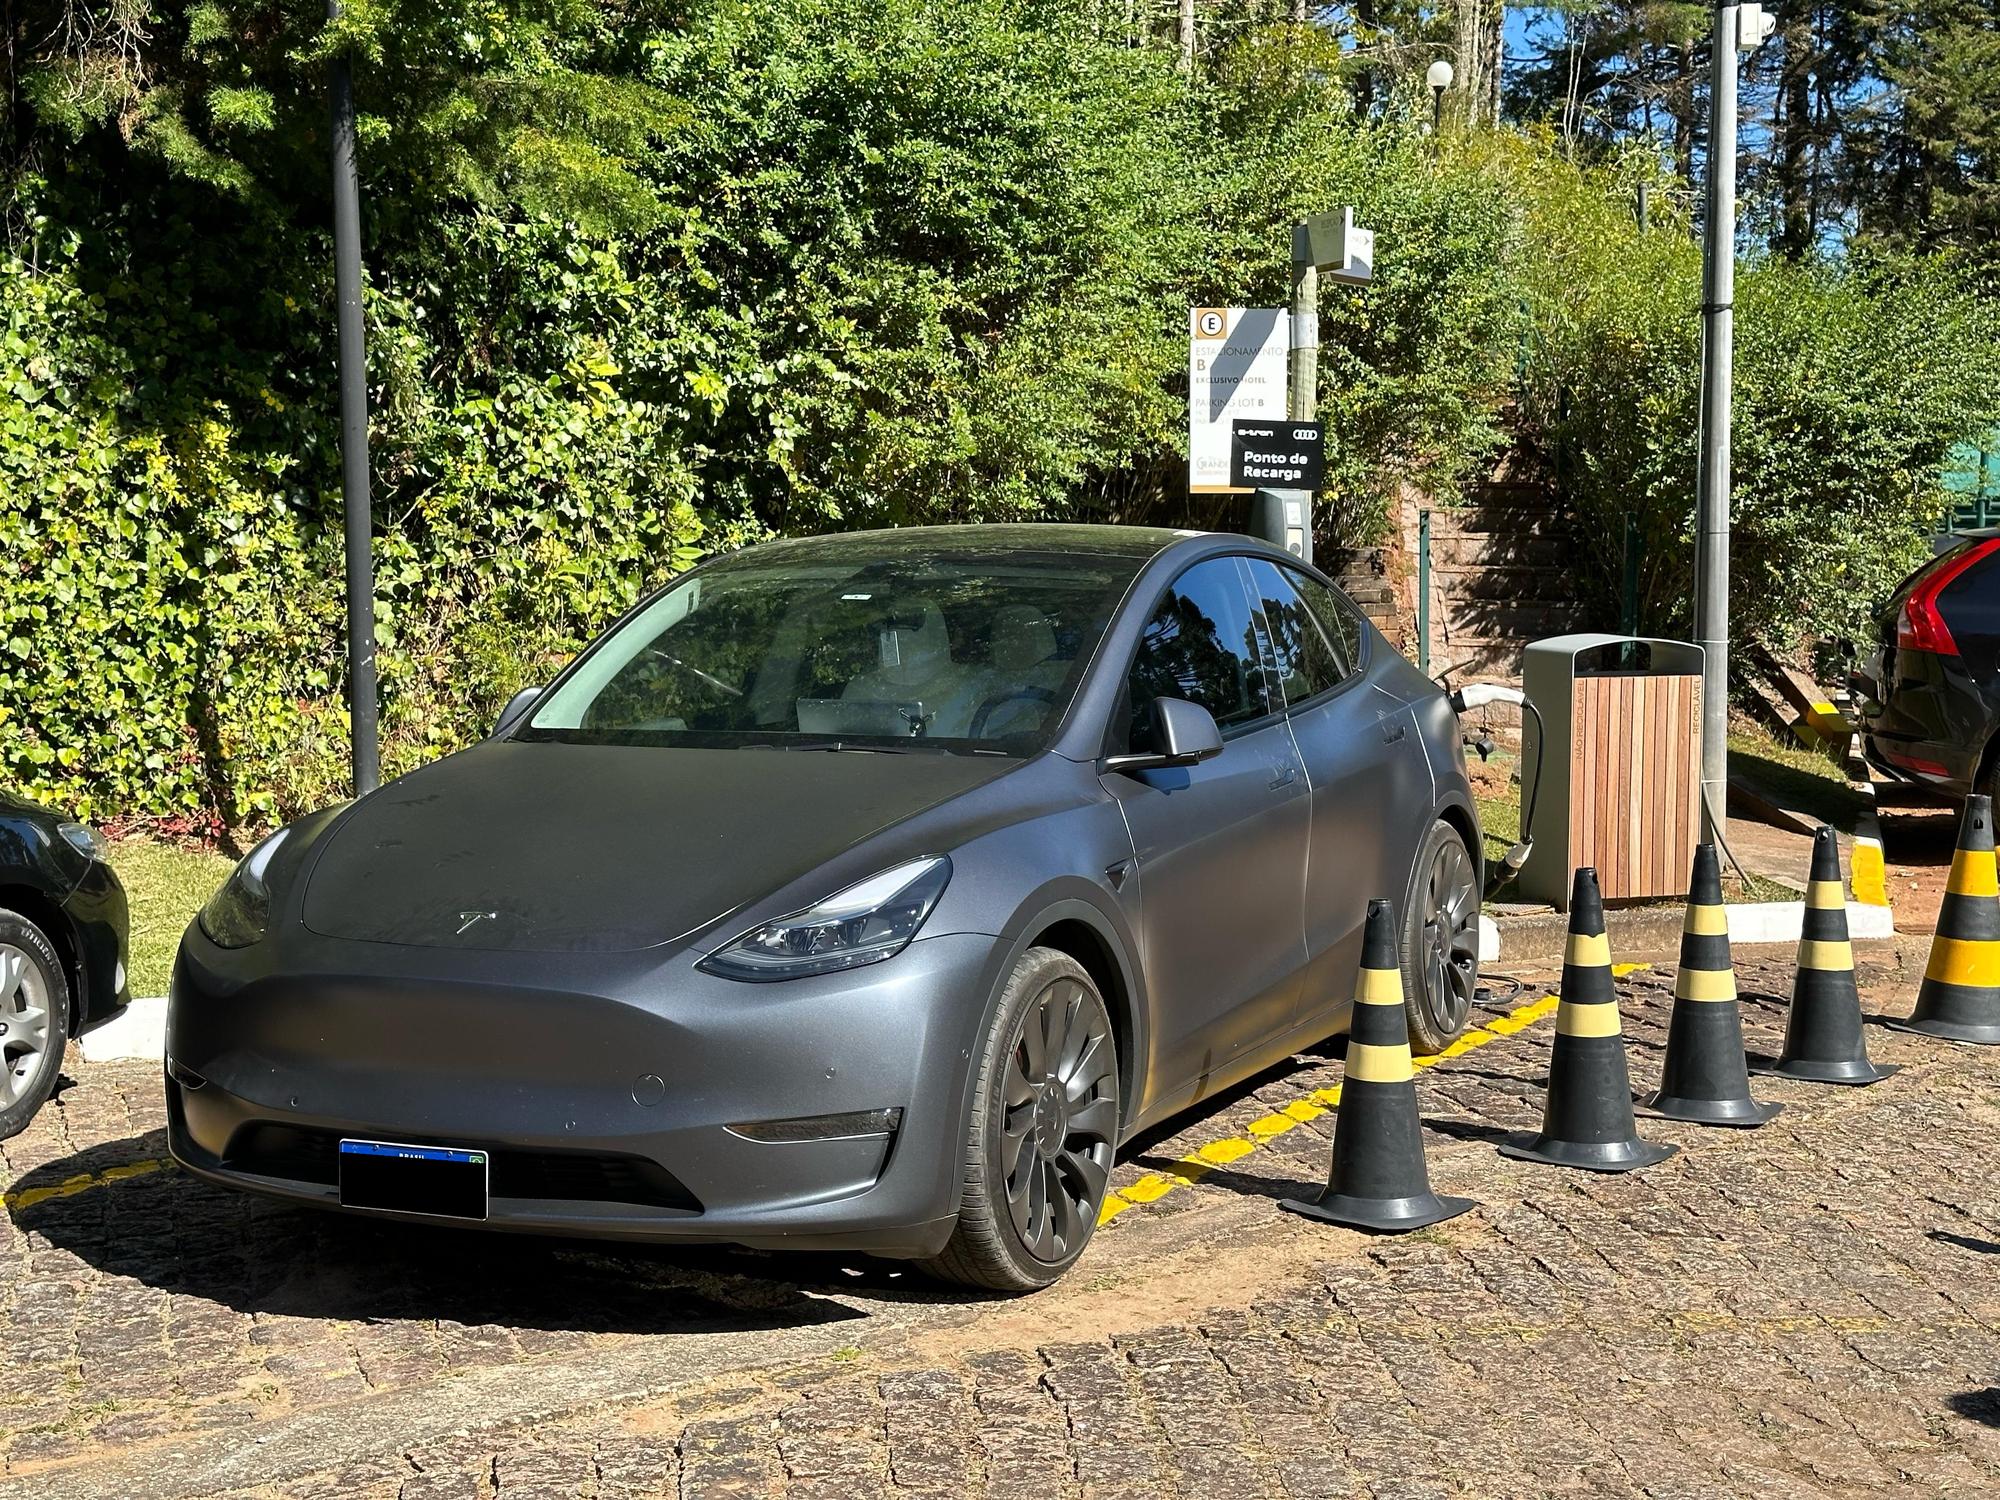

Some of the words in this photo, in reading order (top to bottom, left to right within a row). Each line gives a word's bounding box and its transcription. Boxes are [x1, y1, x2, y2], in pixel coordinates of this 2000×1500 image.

[1208, 317, 1216, 330] E
[1197, 359, 1206, 371] B
[1195, 376, 1239, 384] EXCLUSIVO
[1195, 398, 1236, 408] PARKING
[1238, 398, 1255, 408] LOT
[1257, 398, 1265, 407] B
[1244, 450, 1287, 464] Ponto
[1289, 453, 1308, 465] de
[1243, 465, 1302, 481] Recarga
[1576, 680, 1585, 737] RECICLÁVEL
[1693, 679, 1701, 735] RECICLÁVEL
[1575, 739, 1583, 760] NÃO
